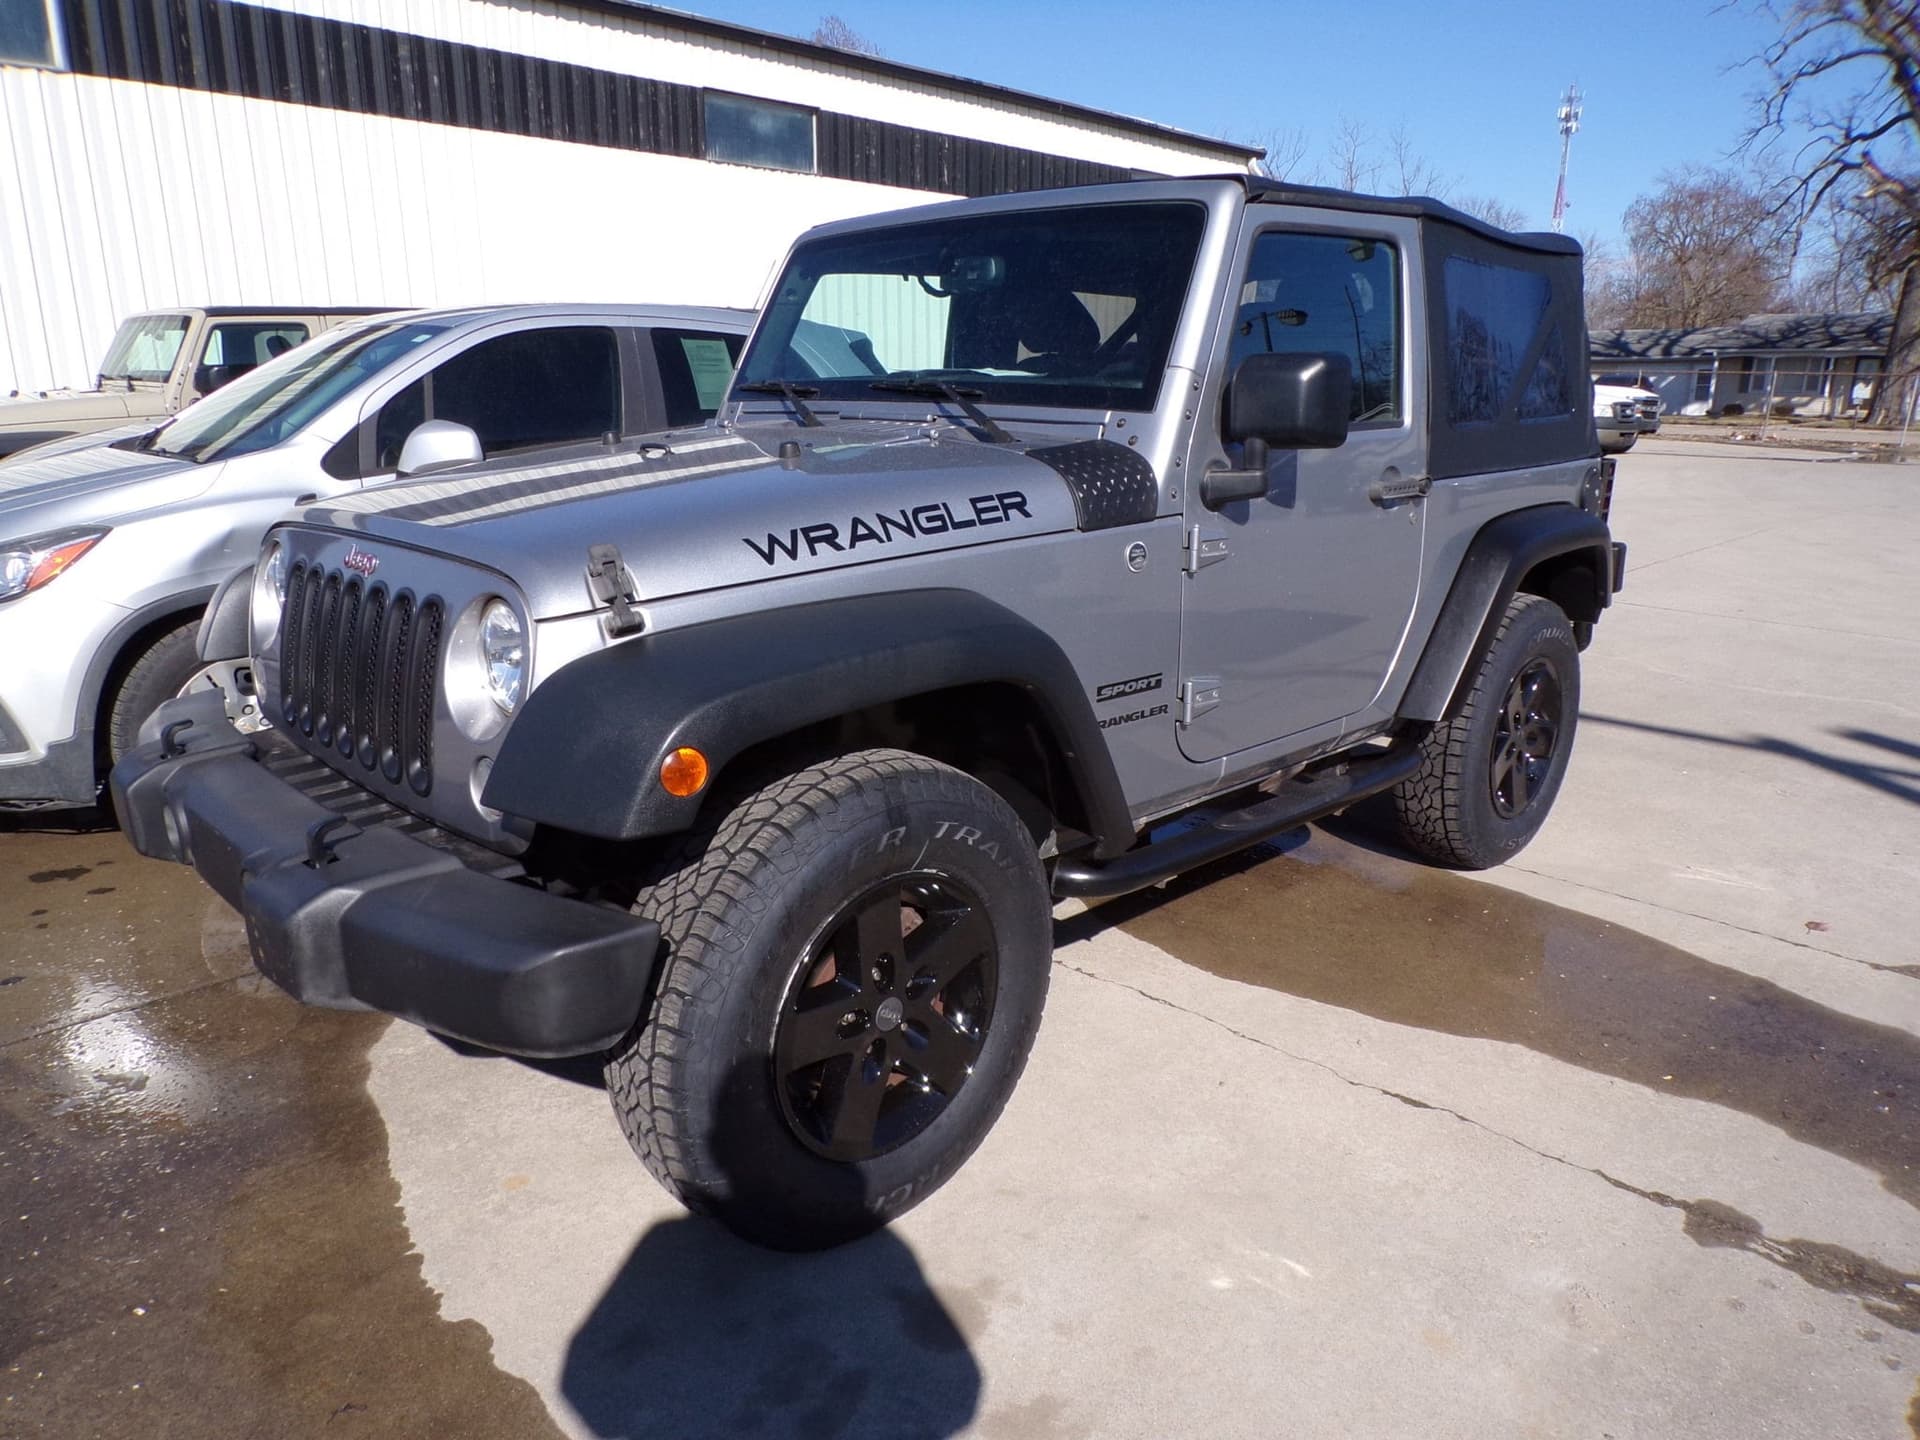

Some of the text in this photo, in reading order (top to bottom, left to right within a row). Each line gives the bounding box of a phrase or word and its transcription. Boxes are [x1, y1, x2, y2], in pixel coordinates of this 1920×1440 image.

[742, 491, 1032, 565] WRANGLER
[1097, 675, 1162, 700] SPORT
[1098, 704, 1169, 729] RANGLER
